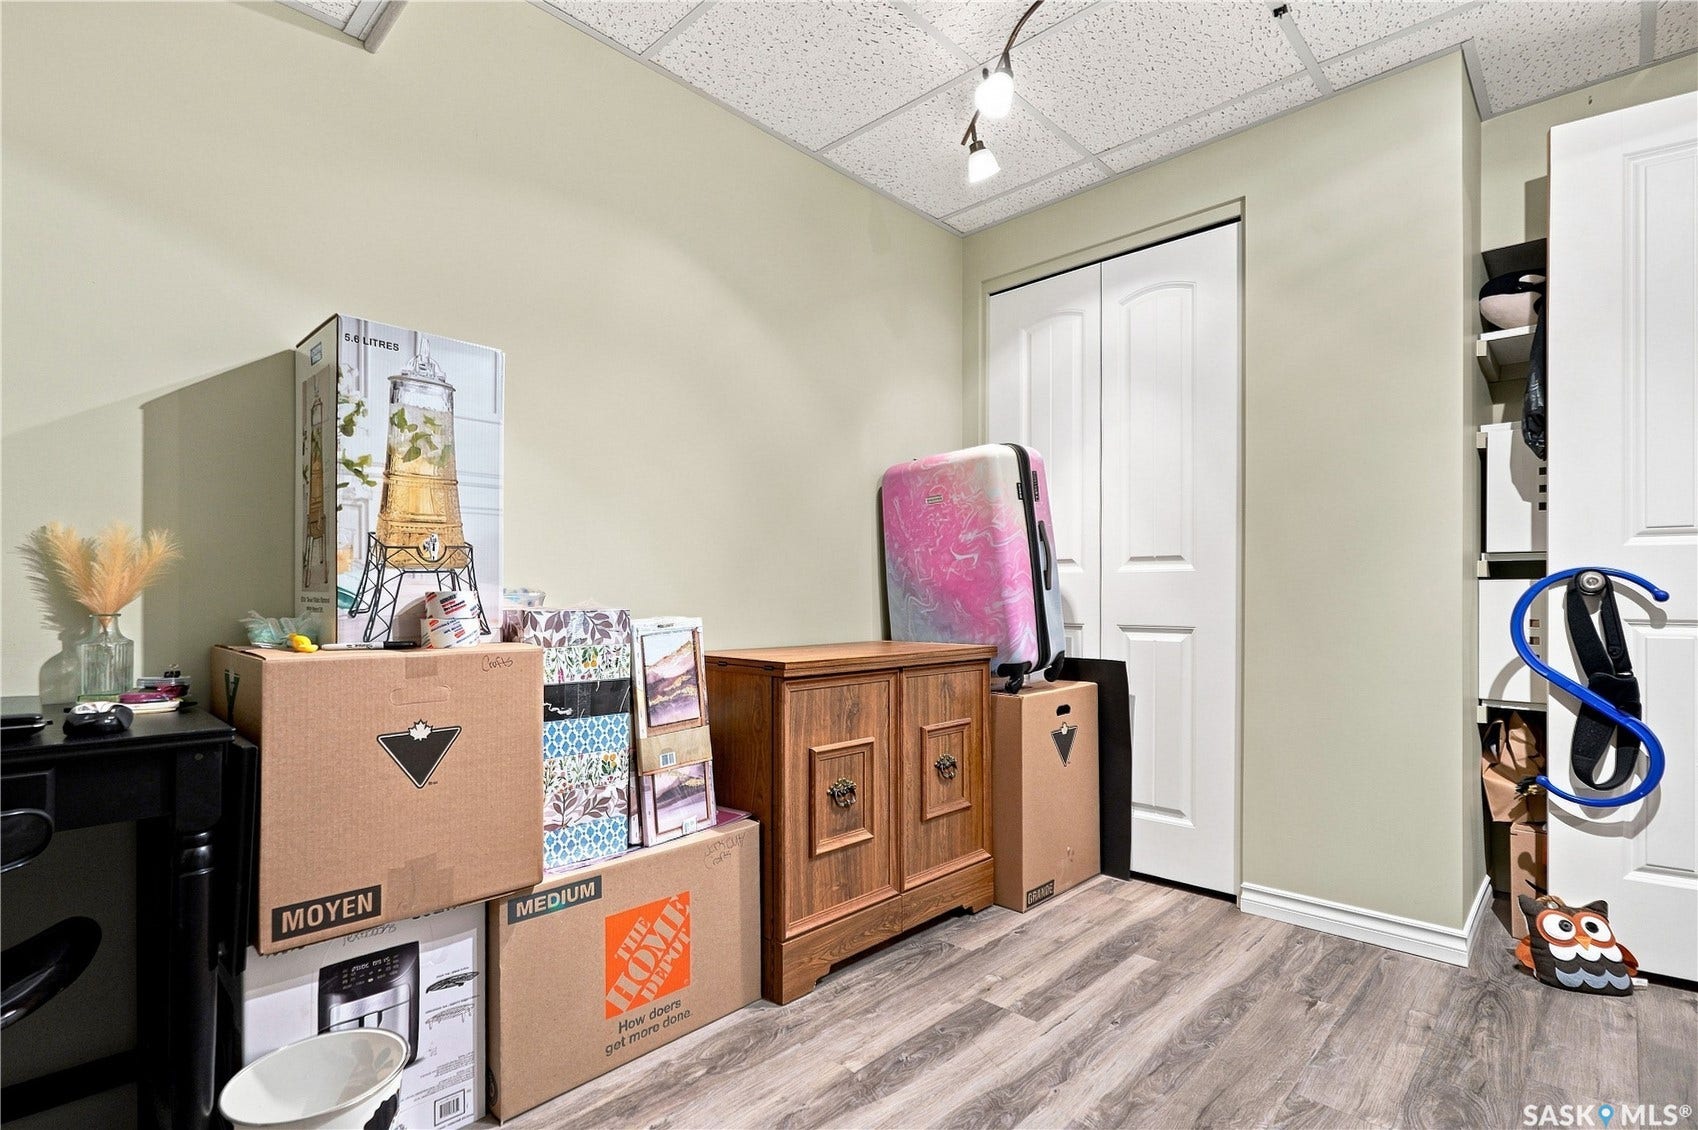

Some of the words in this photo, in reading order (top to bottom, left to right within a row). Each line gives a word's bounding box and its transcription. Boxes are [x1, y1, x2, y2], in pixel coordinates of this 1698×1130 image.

[344, 333, 360, 343] 5.6
[363, 337, 400, 351] LITRES
[481, 655, 514, 672] Crafts
[281, 892, 373, 934] MOYEN
[516, 881, 595, 917] MEDIUM
[606, 894, 690, 1012] HOME
[614, 916, 651, 961] THE
[640, 928, 690, 1001] DEPOT
[605, 1036, 626, 1057] get
[629, 1022, 660, 1044] more
[663, 1009, 693, 1028] done.
[618, 1013, 646, 1034] How
[649, 999, 682, 1021] doers
